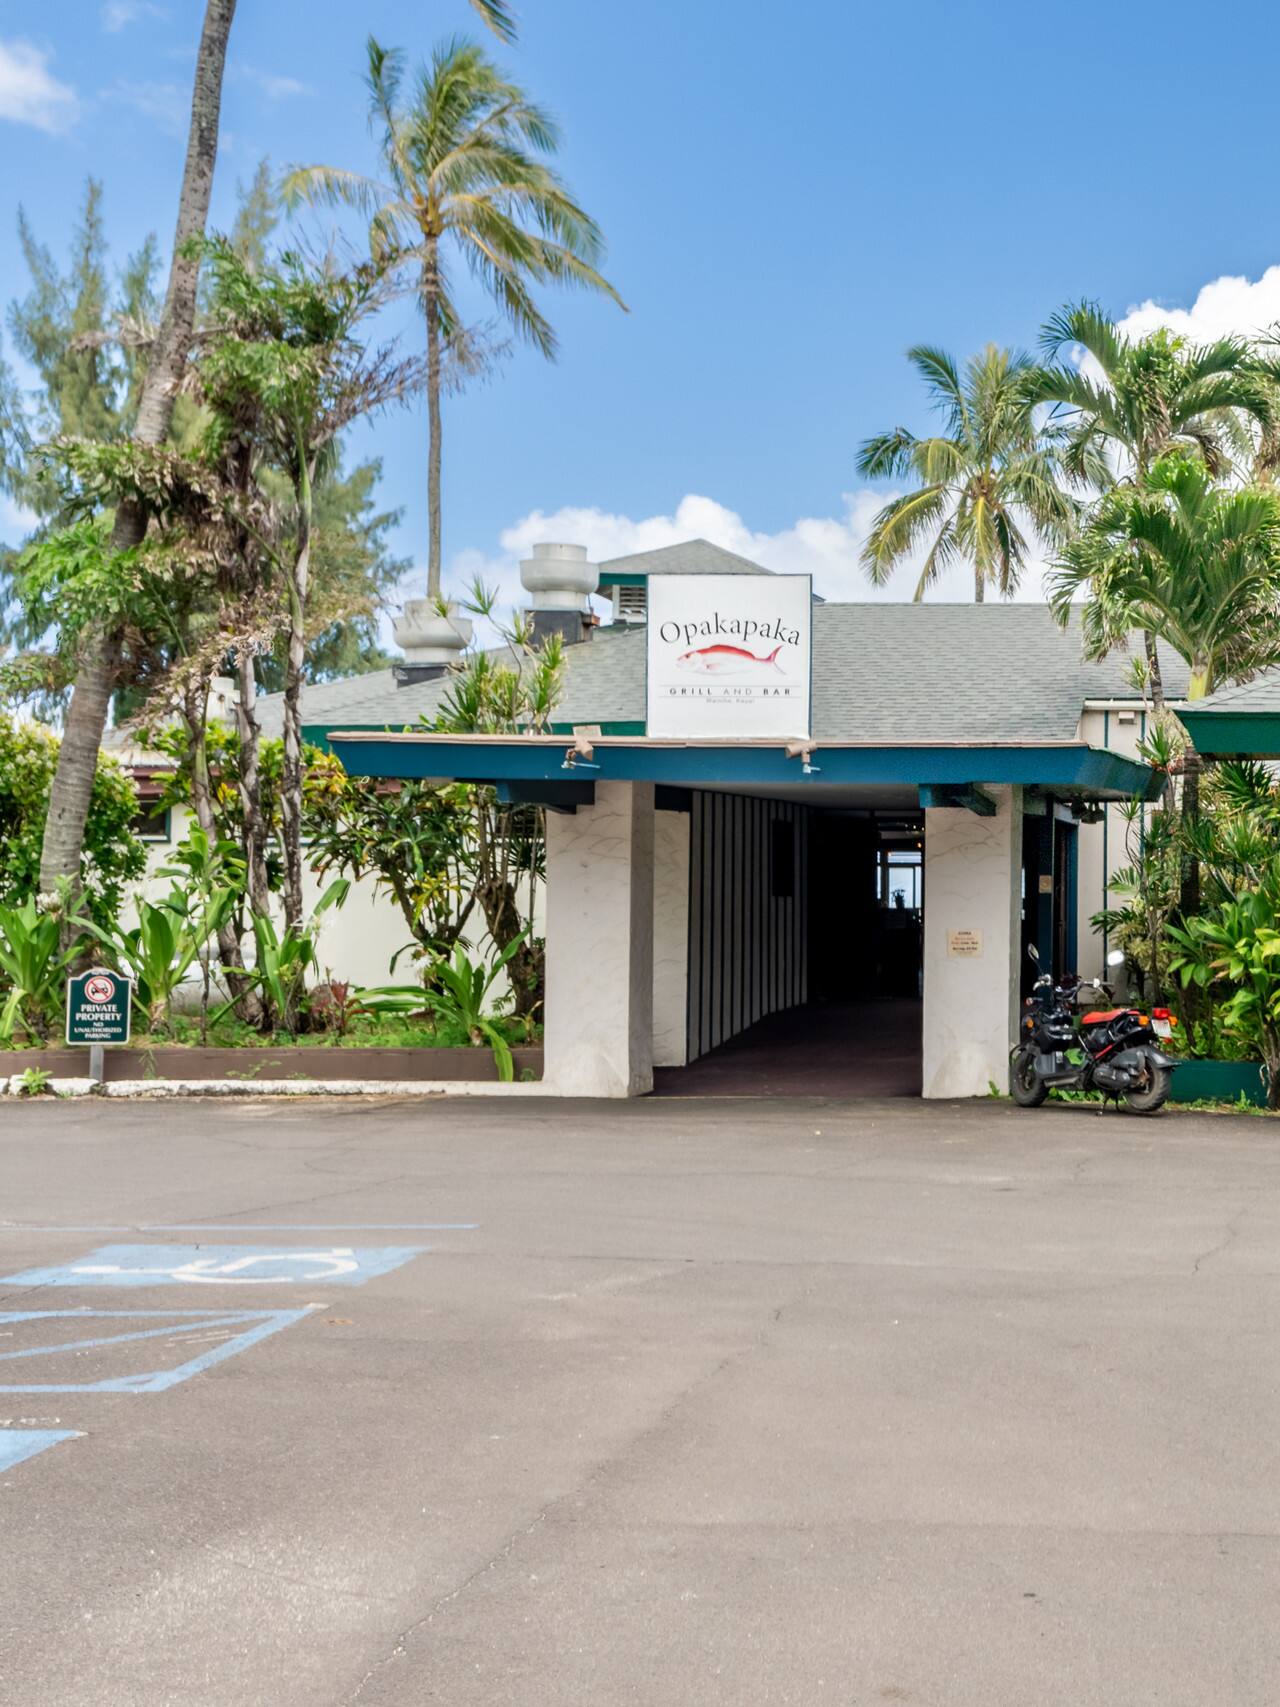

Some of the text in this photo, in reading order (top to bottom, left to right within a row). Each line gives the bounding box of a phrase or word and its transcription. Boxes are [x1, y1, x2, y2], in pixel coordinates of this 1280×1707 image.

[660, 611, 801, 646] Opakapaka
[669, 687, 791, 696] GRILL AND BAR
[80, 1004, 118, 1012] PRIVATE
[75, 1013, 122, 1021] PROPERTY
